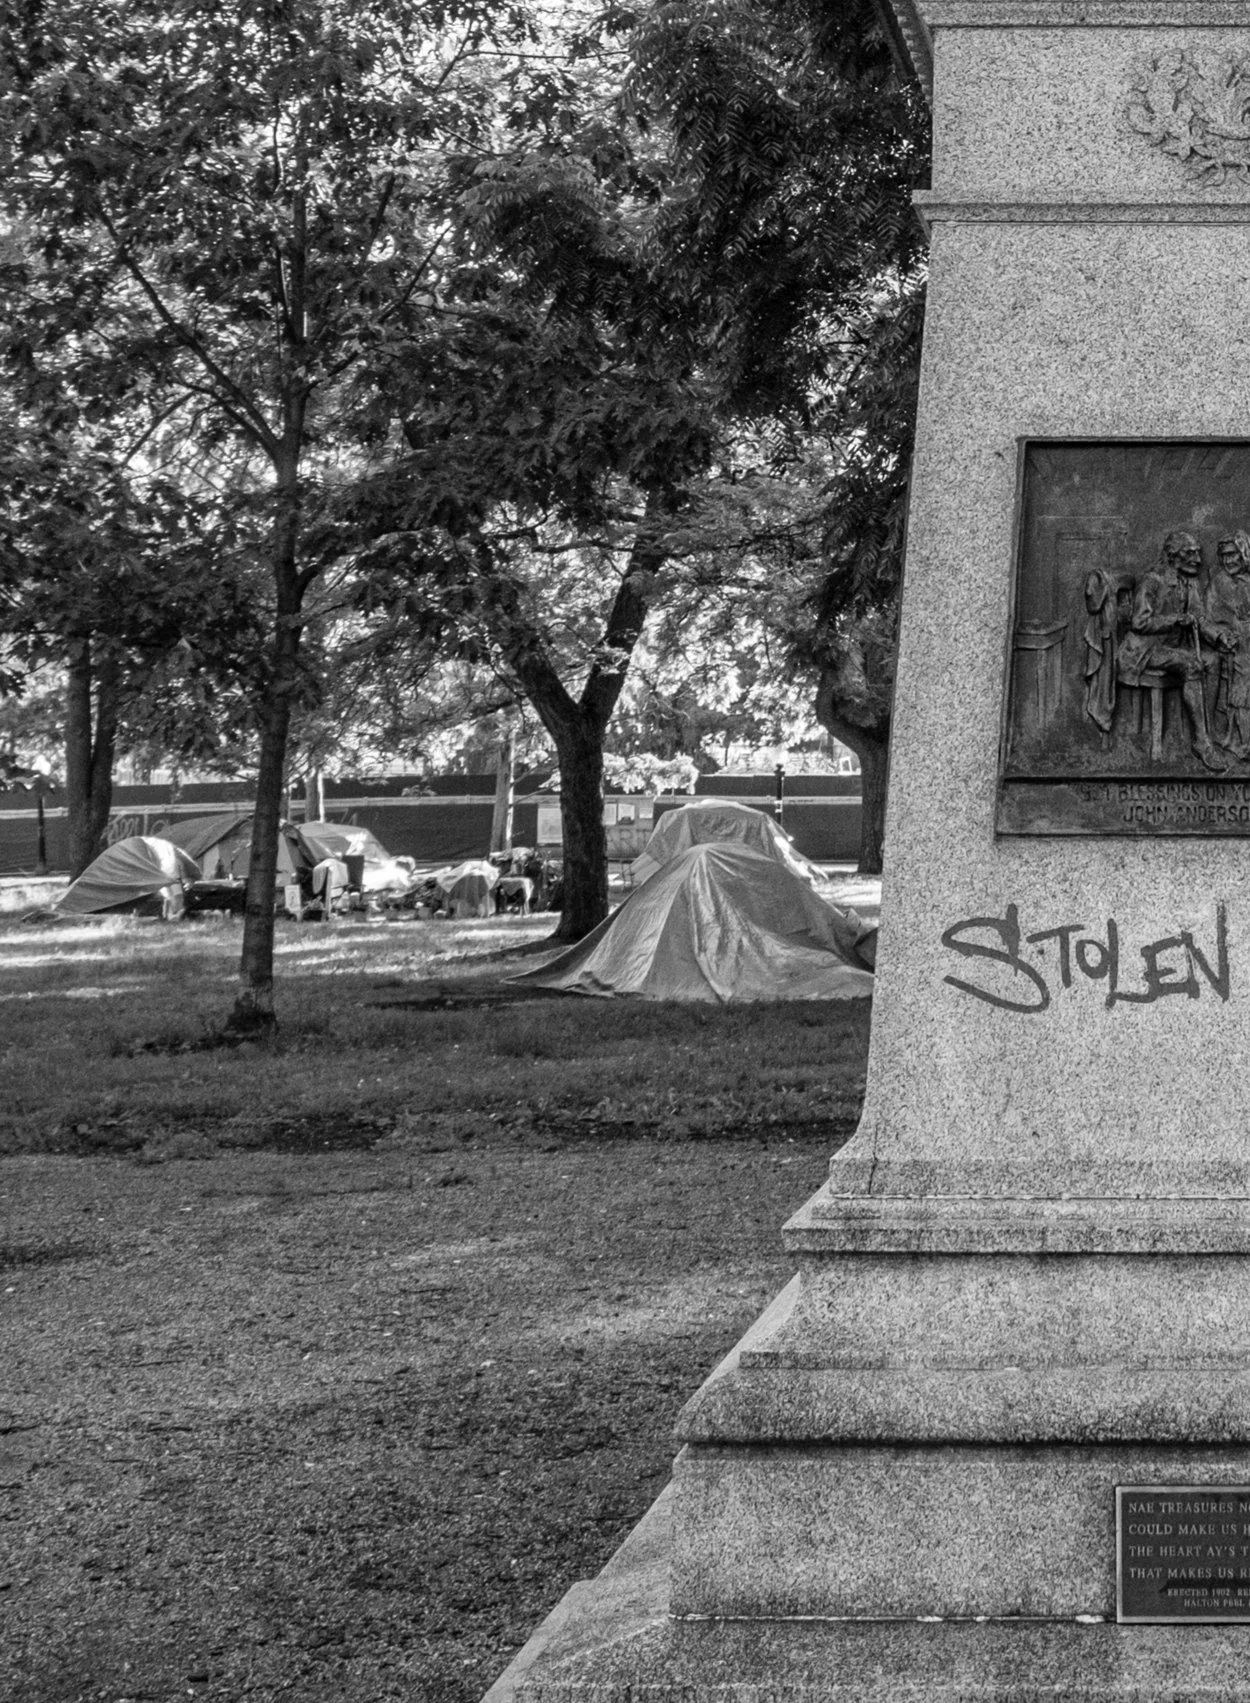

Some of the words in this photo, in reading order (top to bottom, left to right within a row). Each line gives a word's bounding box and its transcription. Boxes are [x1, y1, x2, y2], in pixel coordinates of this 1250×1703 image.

[1206, 783, 1226, 802] ON
[1123, 805, 1169, 823] JOHN
[942, 900, 1231, 1014] STOLEN
[1159, 1501, 1234, 1513] TREASURES
[1128, 1523, 1173, 1535] COULD
[1178, 1523, 1216, 1535] MAKE
[1221, 1523, 1237, 1535] US
[1128, 1545, 1154, 1557] THE
[1159, 1545, 1202, 1557] HEART
[1206, 1545, 1236, 1557] AY'S
[1129, 1567, 1163, 1578] THAT
[1167, 1567, 1213, 1578] MAKES
[1218, 1567, 1234, 1578] US
[1167, 1588, 1209, 1597] ERECTED
[1211, 1588, 1231, 1597] 1902
[1183, 1598, 1220, 1607] HALTON
